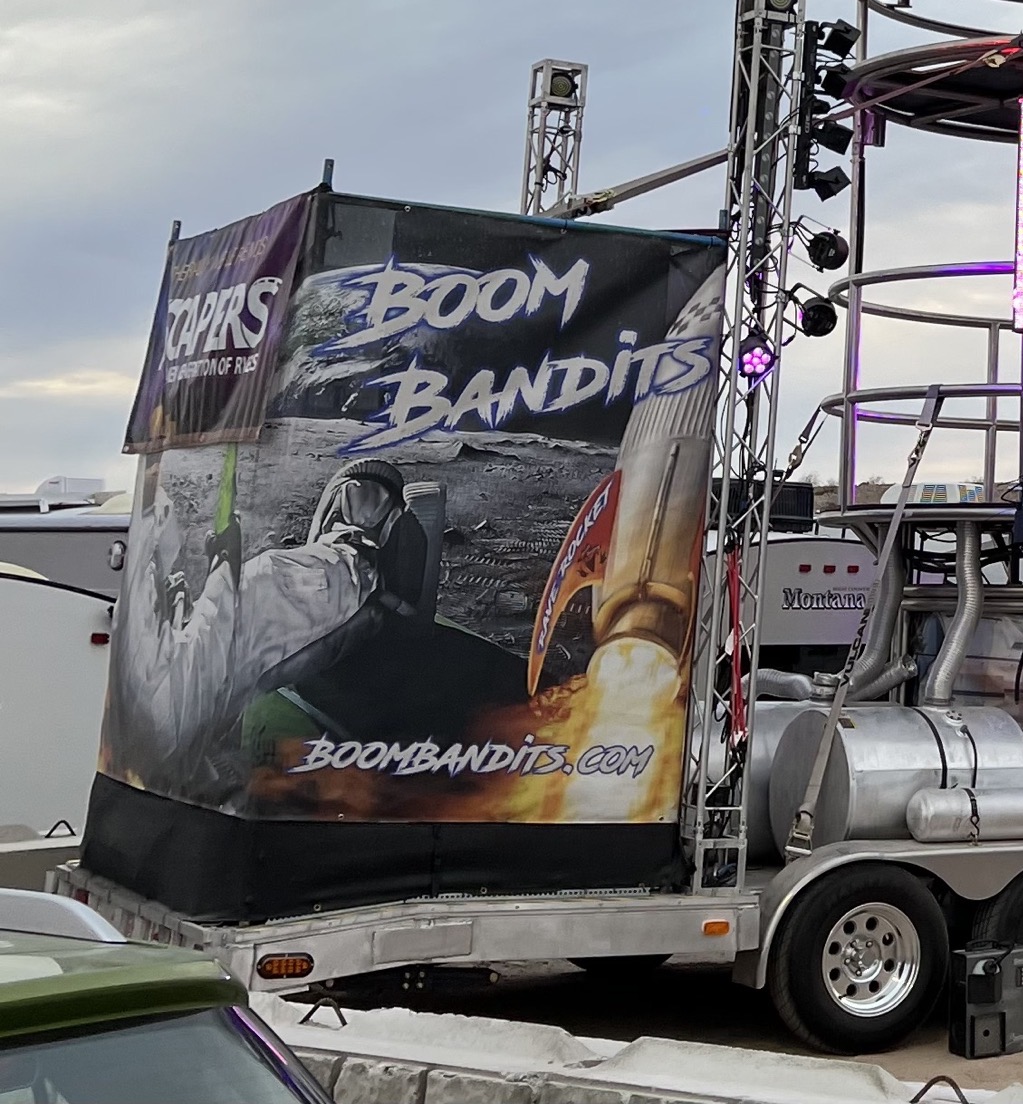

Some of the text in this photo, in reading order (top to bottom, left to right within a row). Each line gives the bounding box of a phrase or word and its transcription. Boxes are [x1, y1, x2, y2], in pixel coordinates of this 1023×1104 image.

[316, 253, 590, 353] BOOM
[341, 328, 712, 454] BANDITS
[557, 480, 614, 578] ROCKET
[782, 587, 867, 610] Montana
[839, 607, 871, 687] VULCAN
[287, 731, 655, 779] BOOMBANDITS.COM
